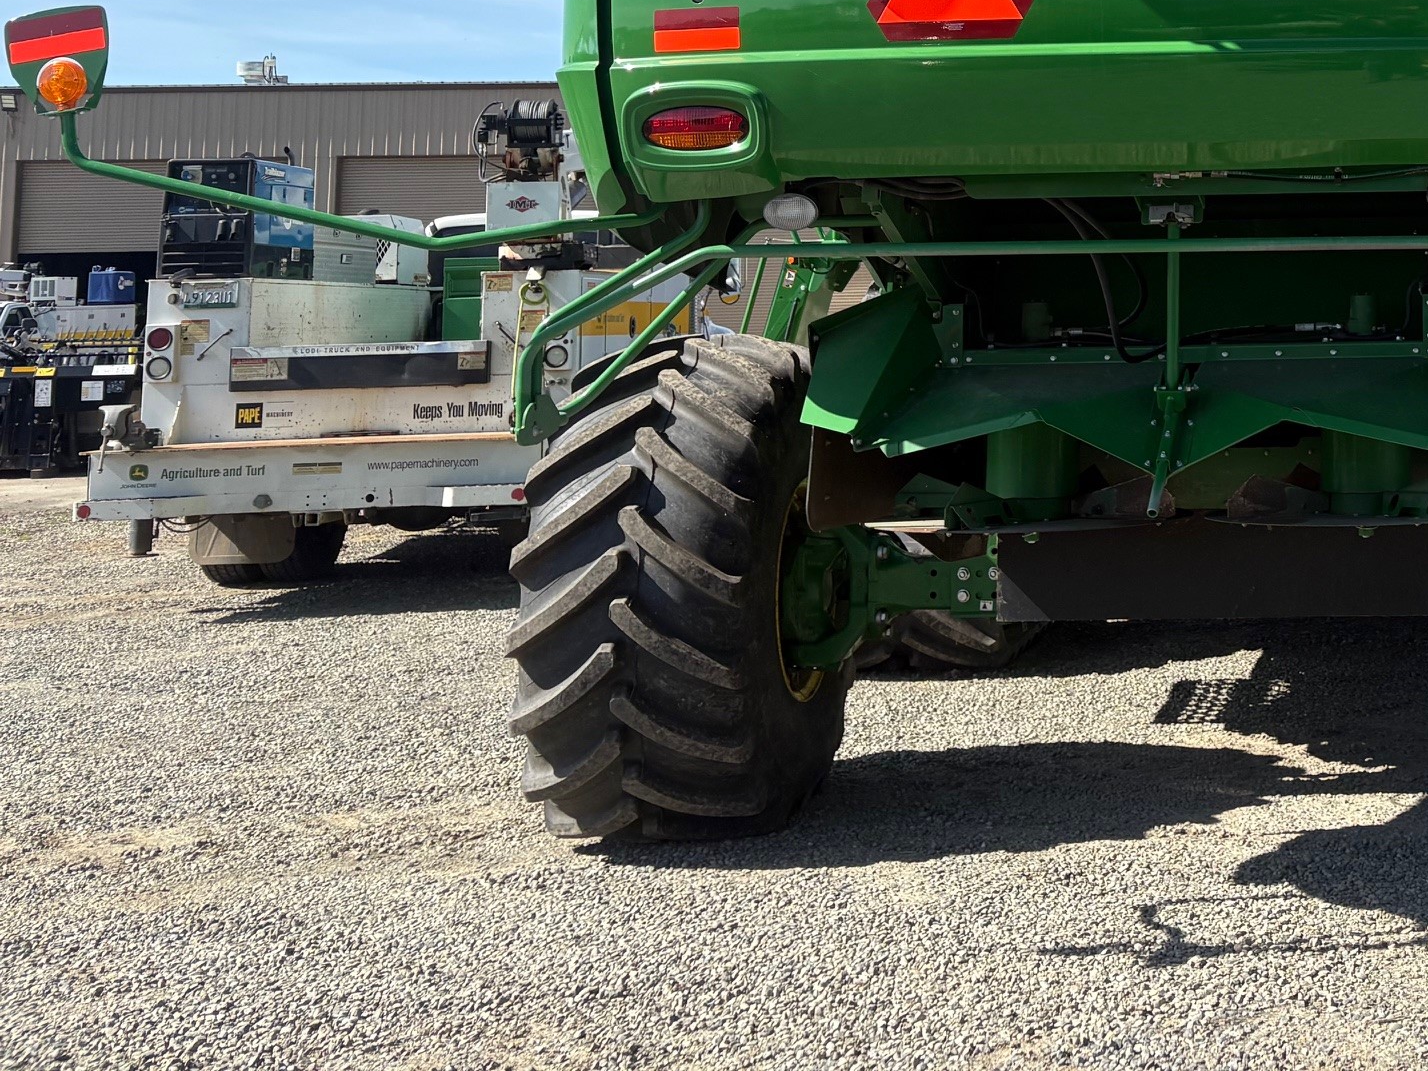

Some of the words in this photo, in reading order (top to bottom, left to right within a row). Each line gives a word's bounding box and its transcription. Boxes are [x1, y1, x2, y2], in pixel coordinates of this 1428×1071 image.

[413, 403, 443, 421] Keeps
[446, 402, 464, 418] You
[468, 400, 503, 418] Moving
[160, 466, 219, 482] Agriculture
[223, 466, 242, 477] and
[245, 464, 266, 477] Turf
[367, 458, 479, 472] www.papemachinery.com
